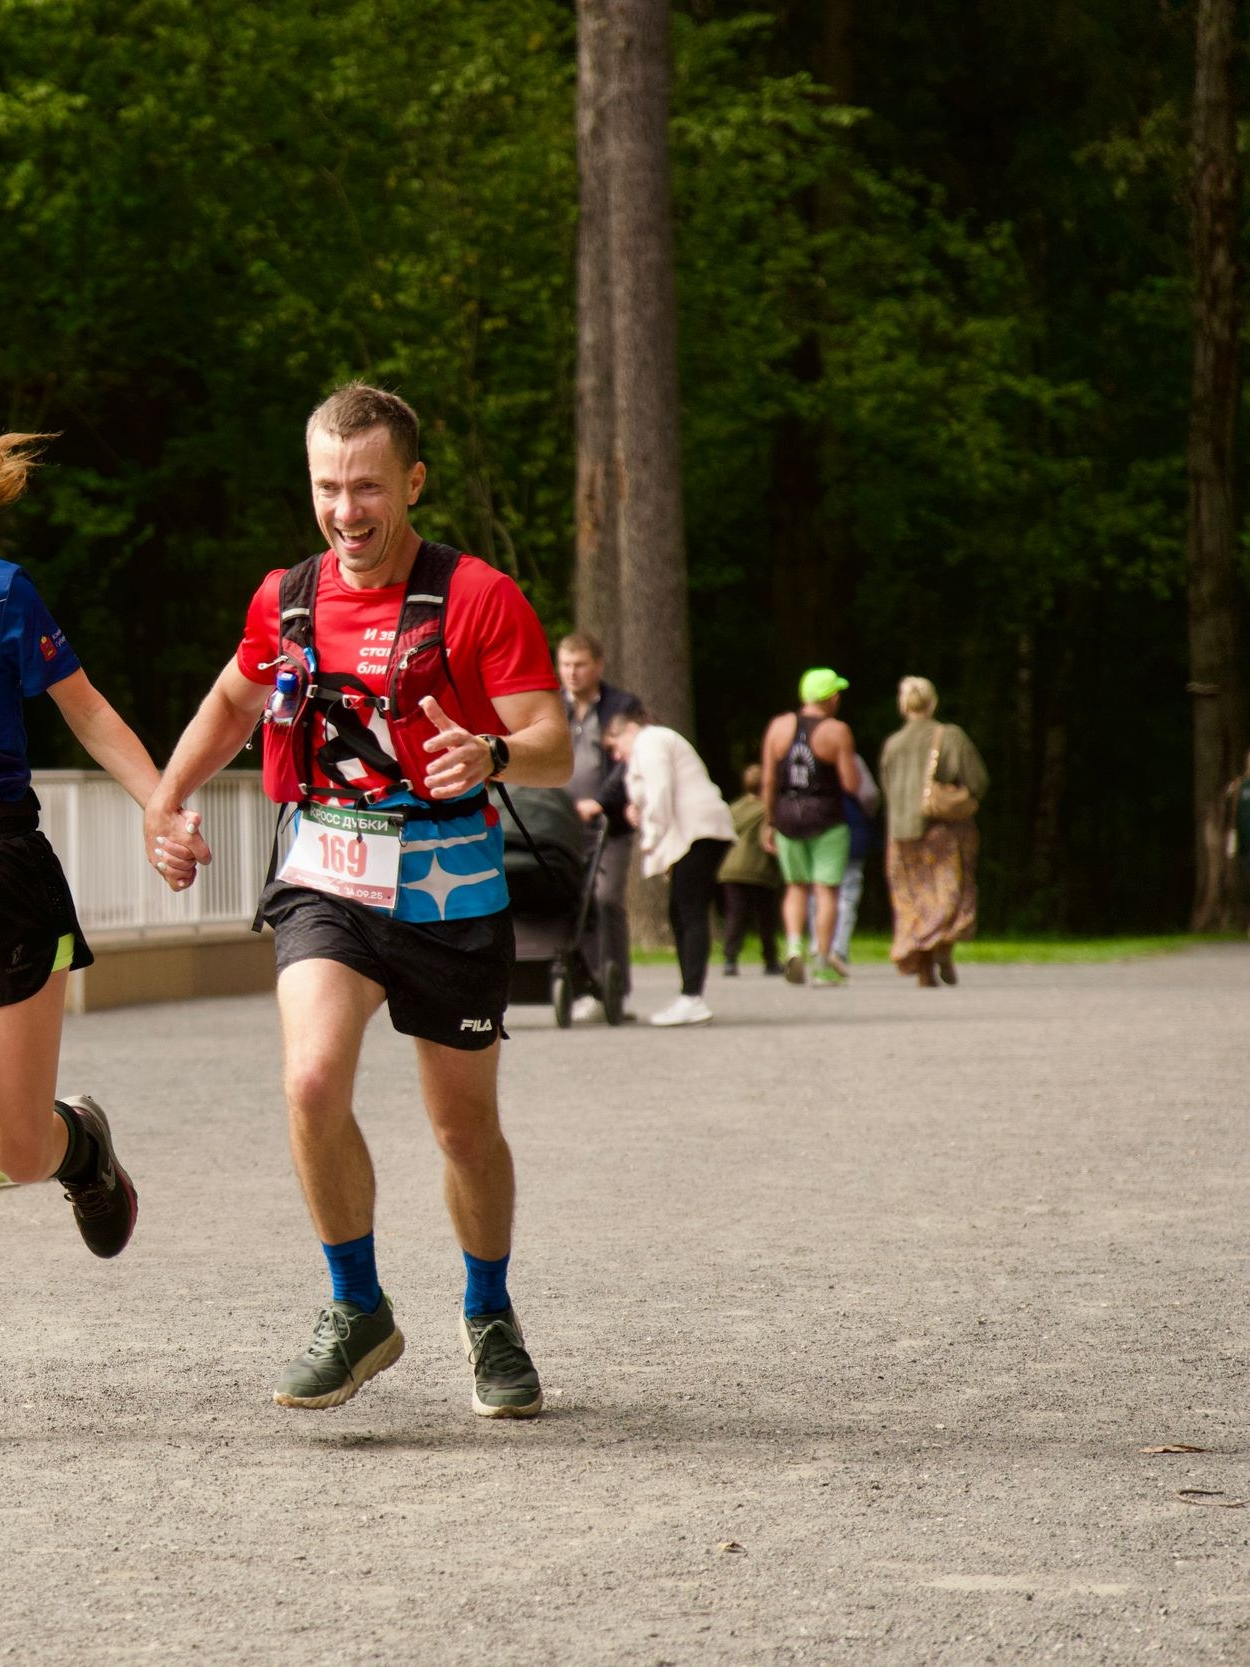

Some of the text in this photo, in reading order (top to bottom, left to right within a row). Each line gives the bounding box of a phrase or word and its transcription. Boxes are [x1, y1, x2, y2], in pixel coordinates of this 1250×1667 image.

[363, 628, 397, 641] И зв
[359, 647, 392, 657] ста
[356, 661, 388, 675] бли
[310, 807, 389, 832] КРОСС ДУБКИ
[318, 832, 368, 878] 169
[461, 1019, 493, 1032] FILA
